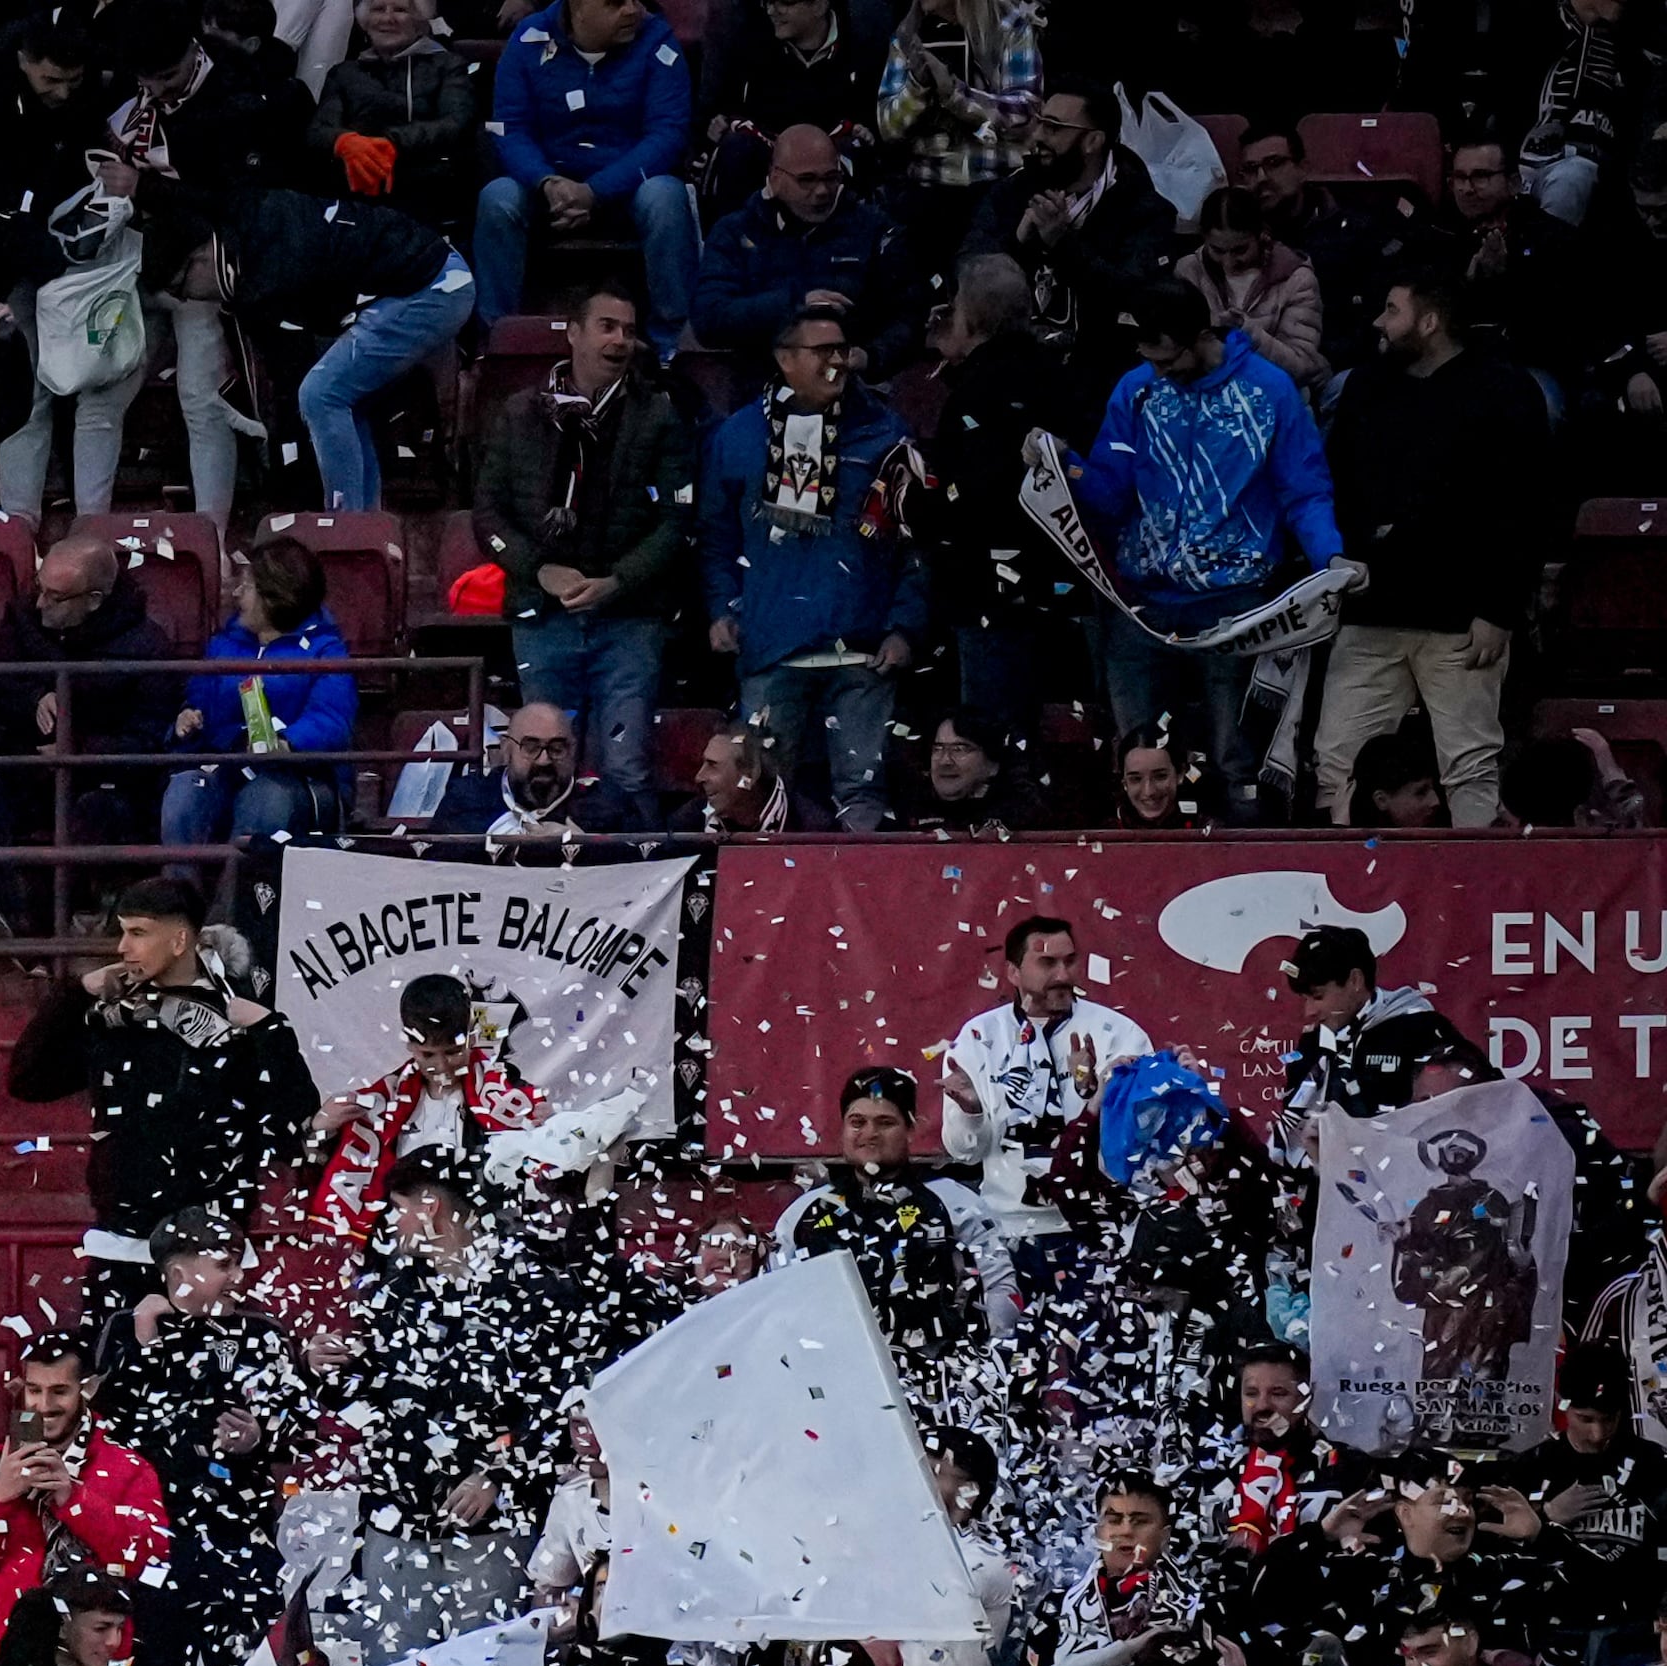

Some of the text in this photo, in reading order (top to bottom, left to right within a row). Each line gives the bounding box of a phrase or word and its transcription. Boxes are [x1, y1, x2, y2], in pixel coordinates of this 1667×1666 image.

[289, 892, 481, 1001] ALBACETE
[1491, 911, 1596, 976] EN
[1489, 1016, 1594, 1081] DE
[1339, 1379, 1407, 1396] Ruega
[1415, 1397, 1458, 1414] SAN
